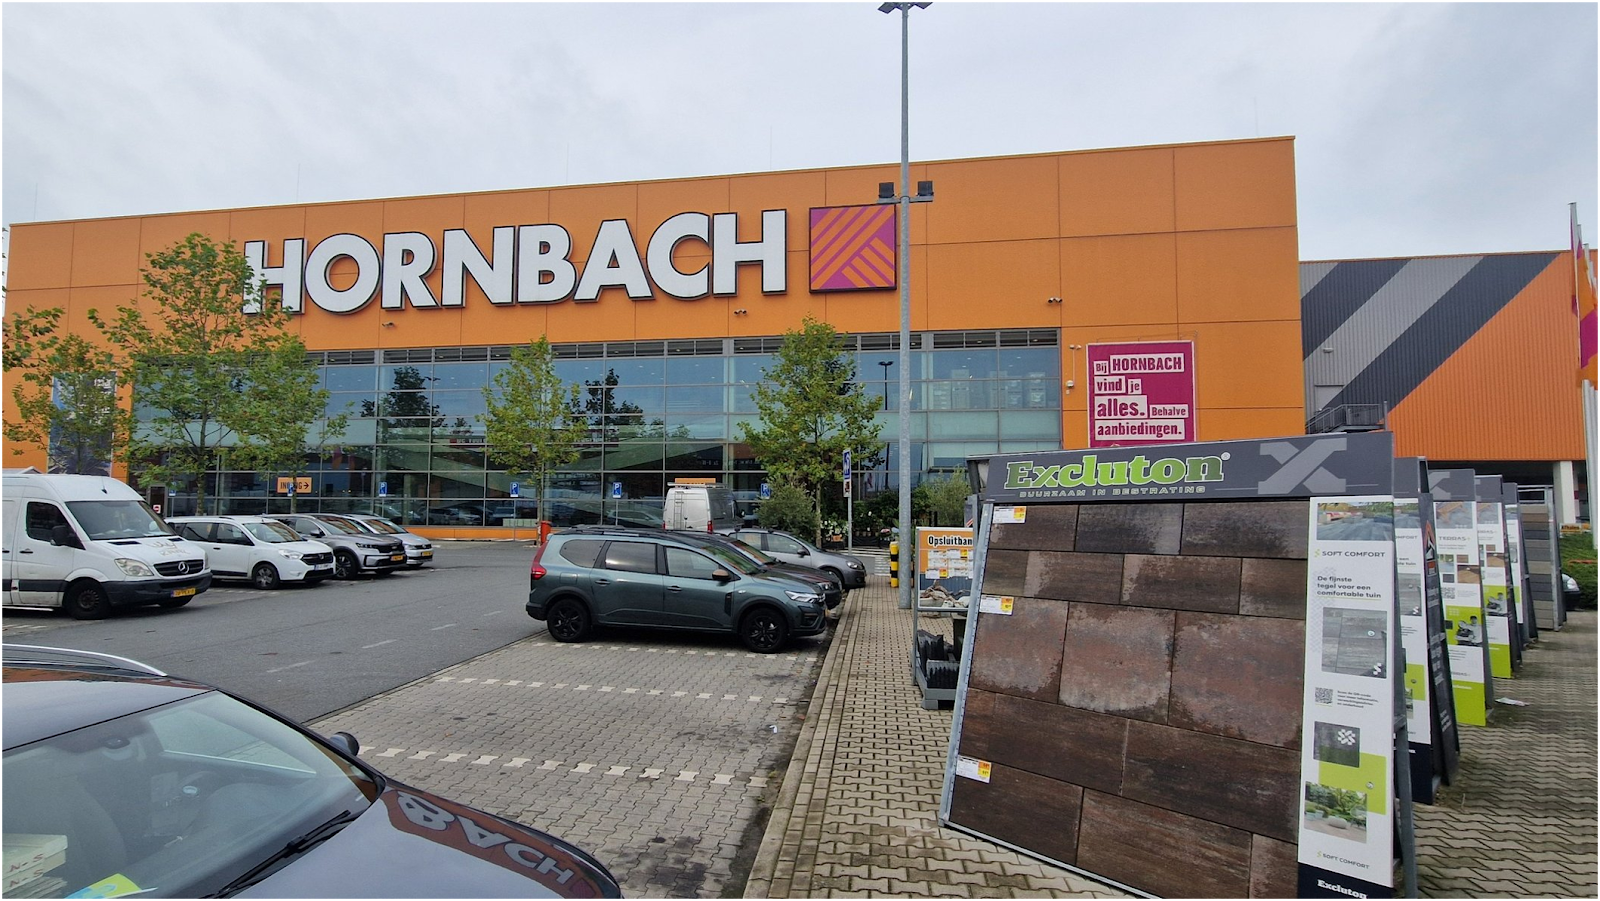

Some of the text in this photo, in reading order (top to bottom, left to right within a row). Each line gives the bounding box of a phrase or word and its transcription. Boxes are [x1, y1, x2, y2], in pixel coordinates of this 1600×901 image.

[243, 208, 788, 315] HORNBACH
[1096, 356, 1182, 373] Bij HORNBACH
[1096, 378, 1140, 393] vind je
[1097, 398, 1186, 417] alles. Behalve
[1097, 421, 1182, 438] aanbiedingen.
[1004, 454, 1225, 490] Excluton
[1019, 485, 1206, 498] DUURZAAM IN BESTRATING
[1329, 575, 1352, 583] fijnste
[1317, 590, 1364, 598] comfortable
[1339, 857, 1370, 869] COMFORT
[1317, 879, 1368, 900] Excluton
